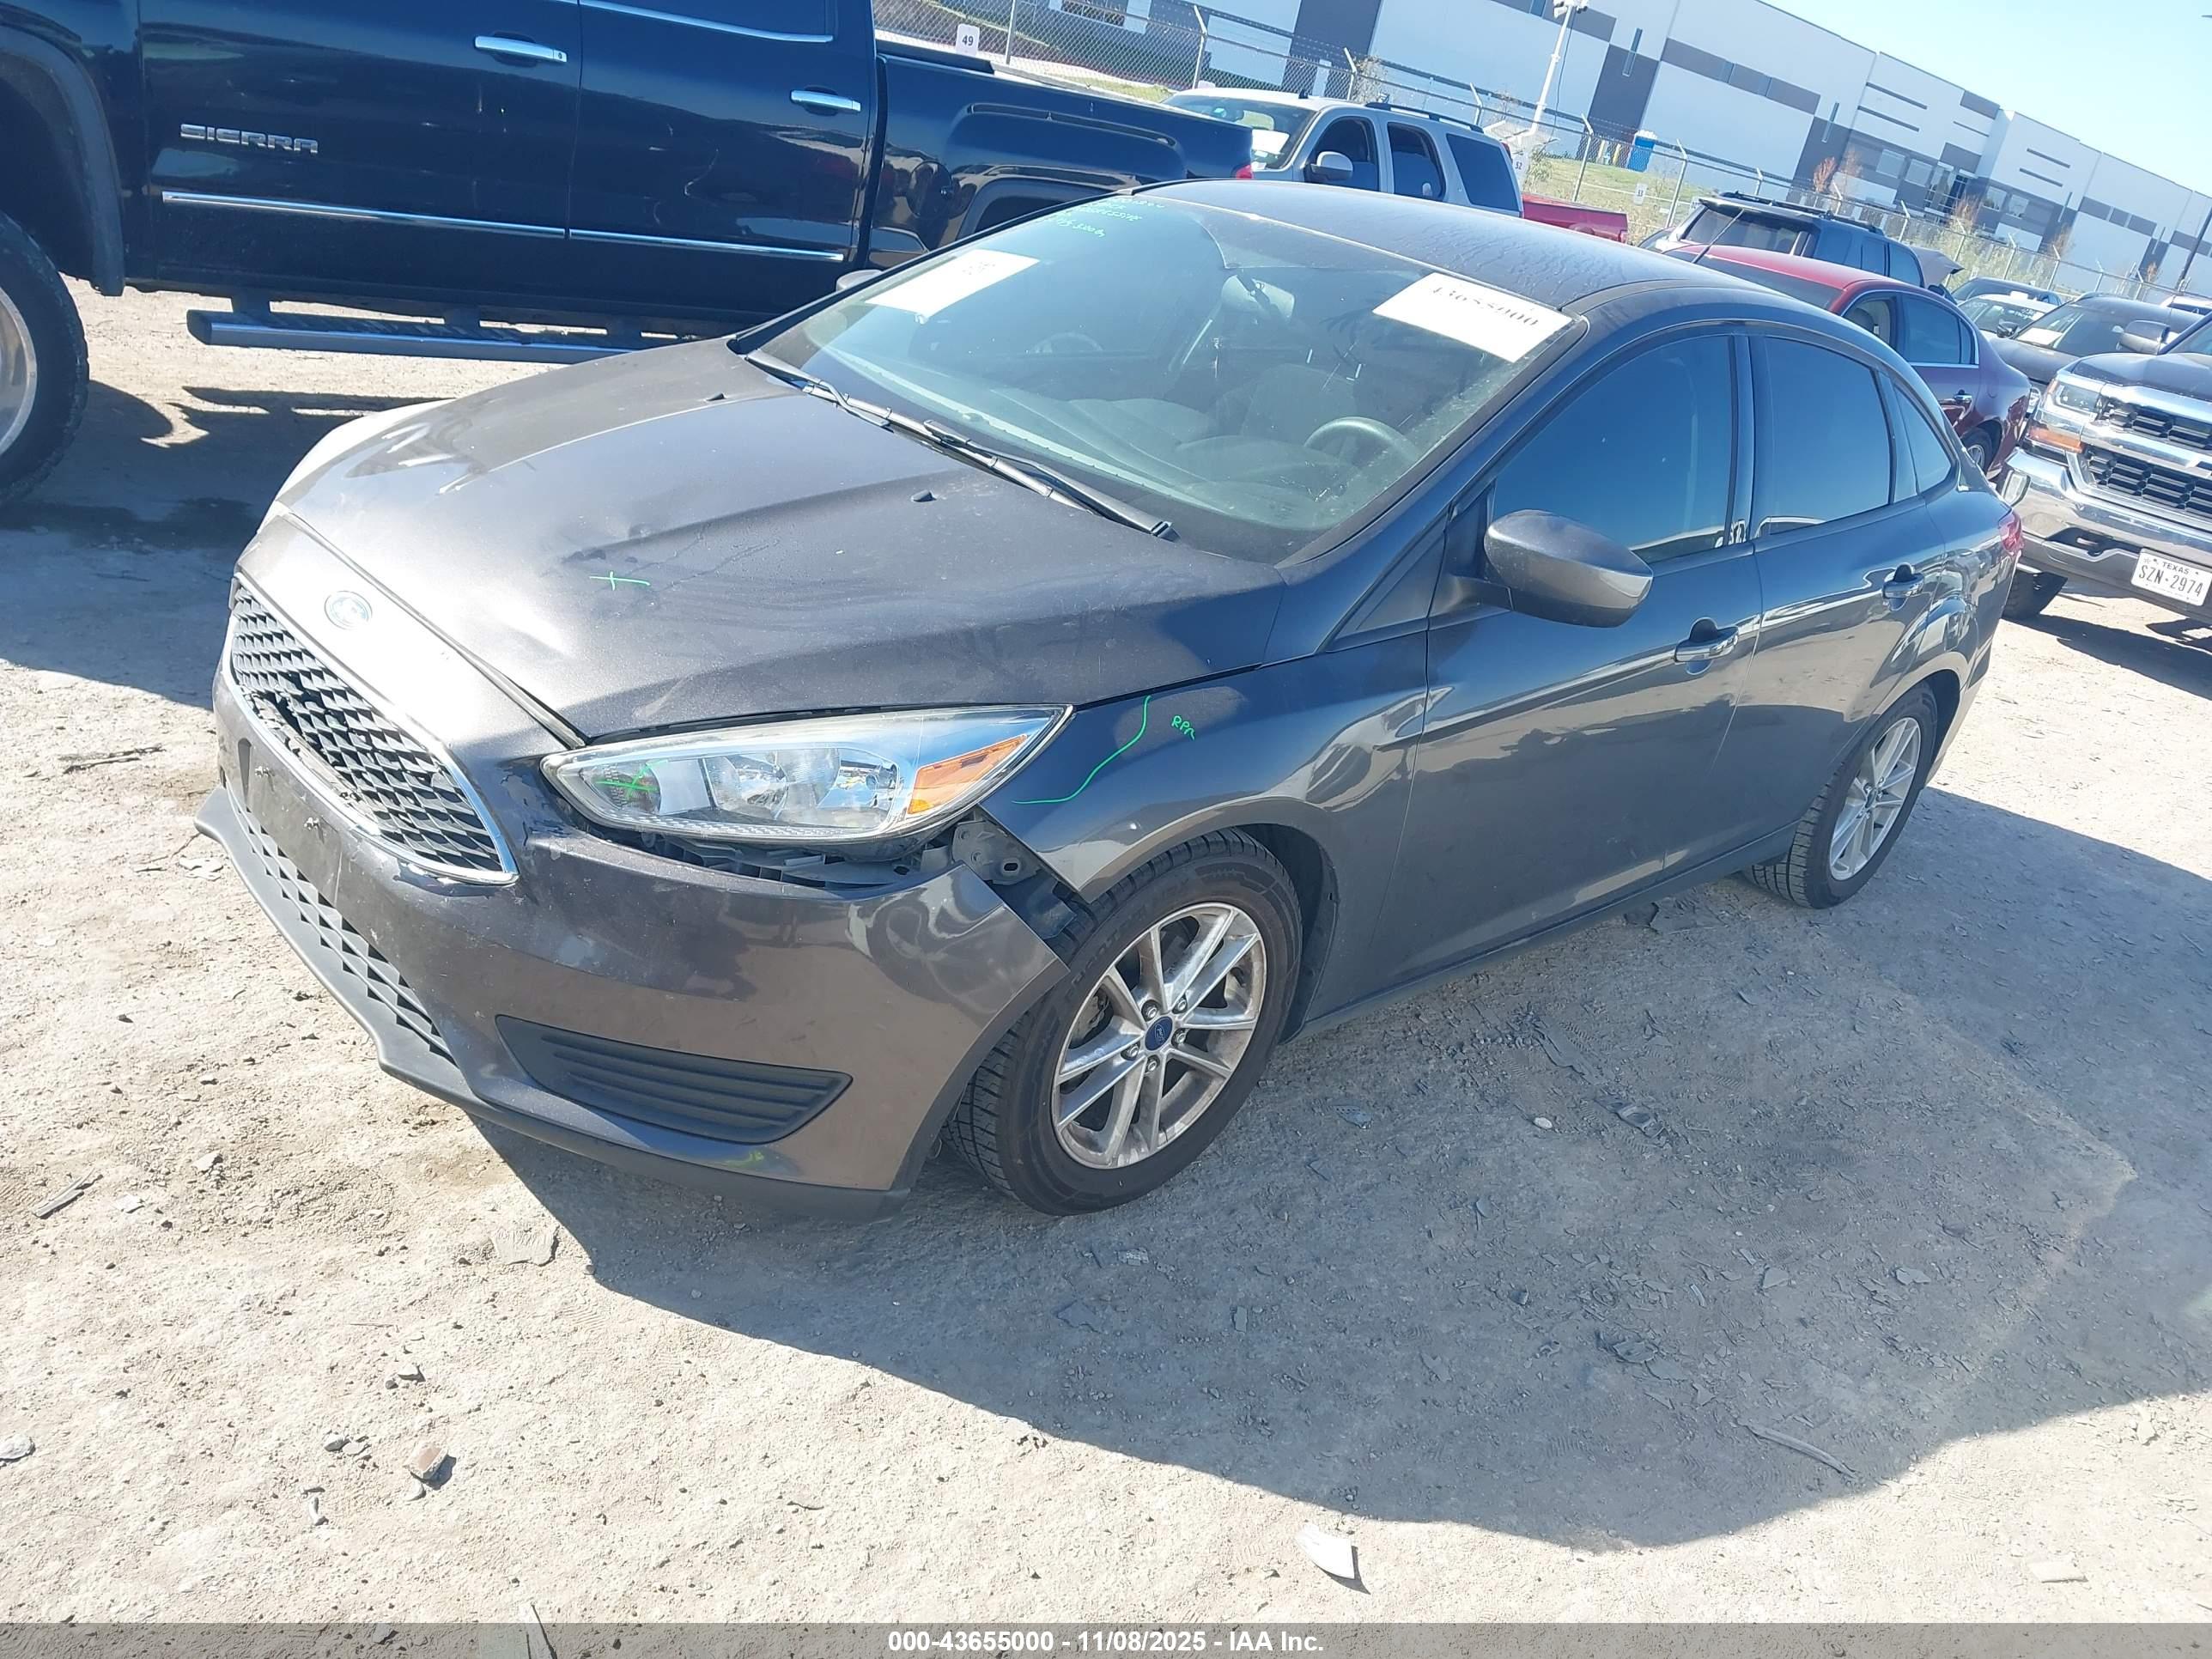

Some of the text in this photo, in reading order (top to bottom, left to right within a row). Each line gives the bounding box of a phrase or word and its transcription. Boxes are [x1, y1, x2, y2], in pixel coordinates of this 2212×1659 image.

[962, 34, 975, 46] 49
[180, 123, 319, 154] SIERRA
[2161, 561, 2190, 574] TEXAS
